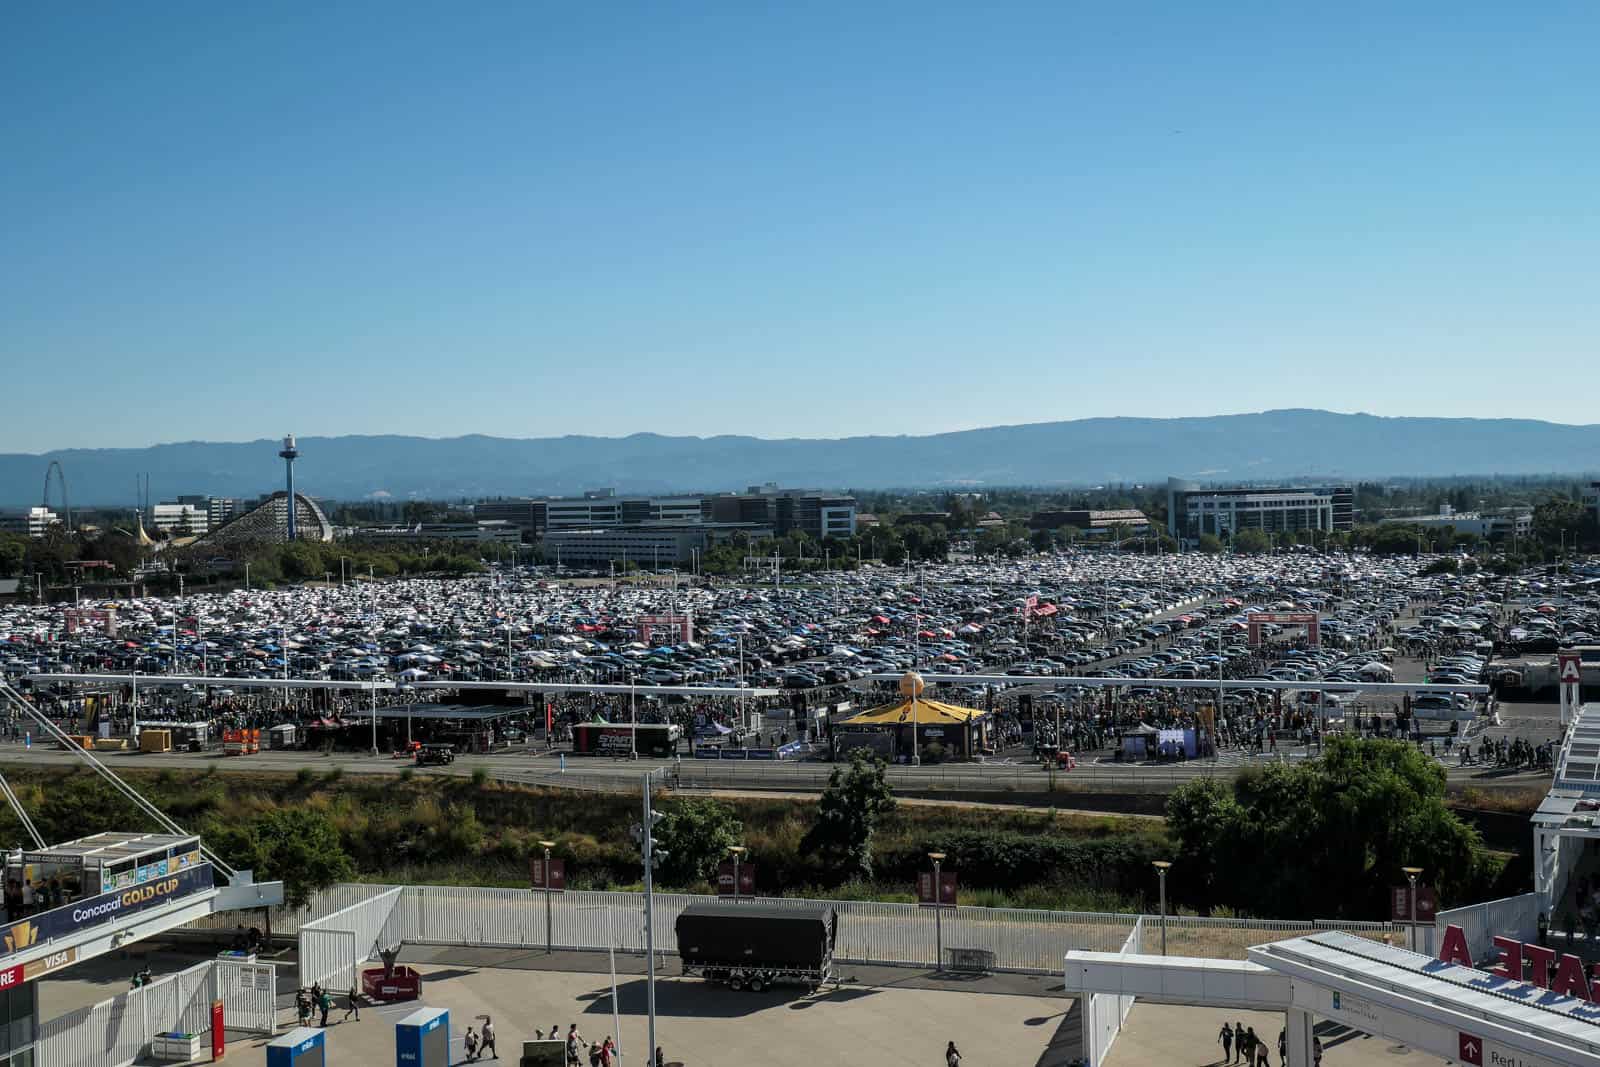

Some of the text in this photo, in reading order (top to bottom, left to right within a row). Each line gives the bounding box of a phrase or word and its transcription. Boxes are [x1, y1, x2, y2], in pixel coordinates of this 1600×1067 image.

[1562, 660, 1580, 679] A
[73, 878, 179, 922] Concacaf GOLD CUP
[43, 951, 68, 969] VISA
